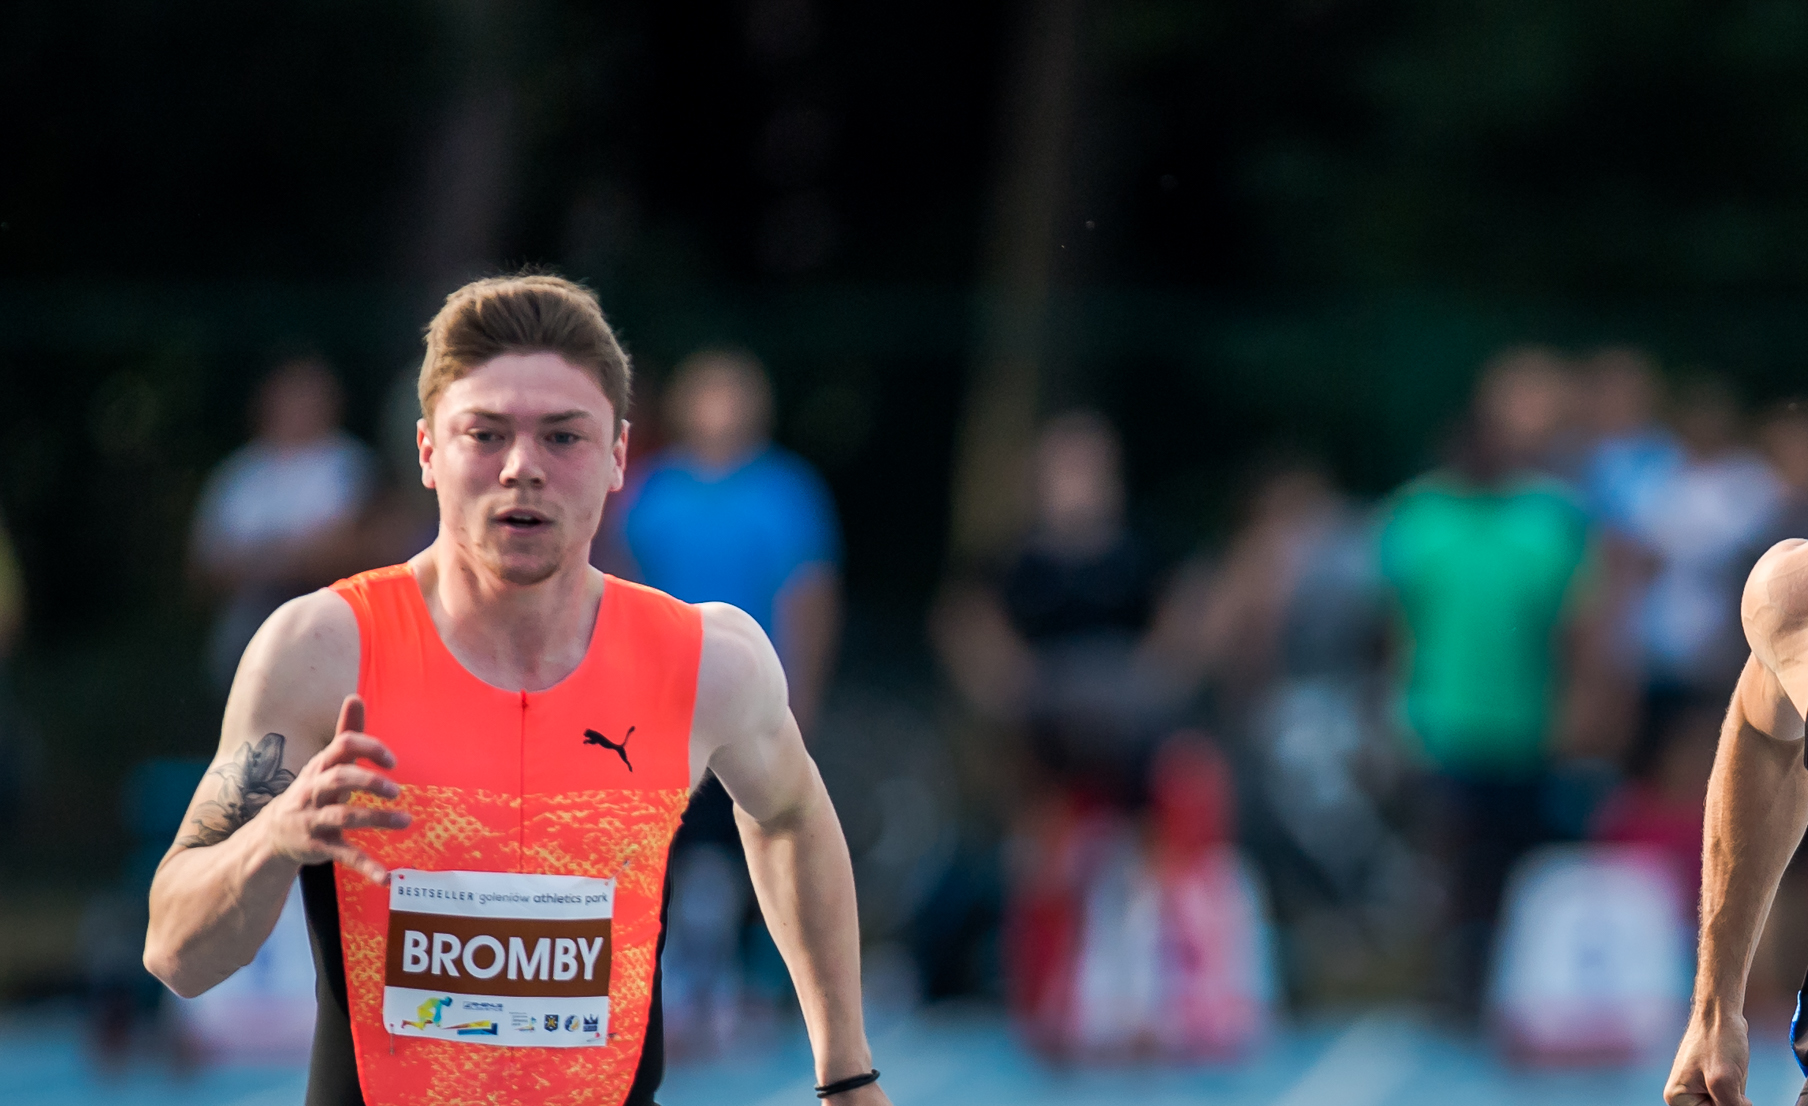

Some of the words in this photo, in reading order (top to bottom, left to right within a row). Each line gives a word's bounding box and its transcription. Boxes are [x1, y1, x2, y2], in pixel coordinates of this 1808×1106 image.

[398, 886, 475, 901] BESTSELLER
[533, 893, 582, 904] athletics
[585, 892, 608, 905] park
[402, 930, 604, 981] BROMBY
